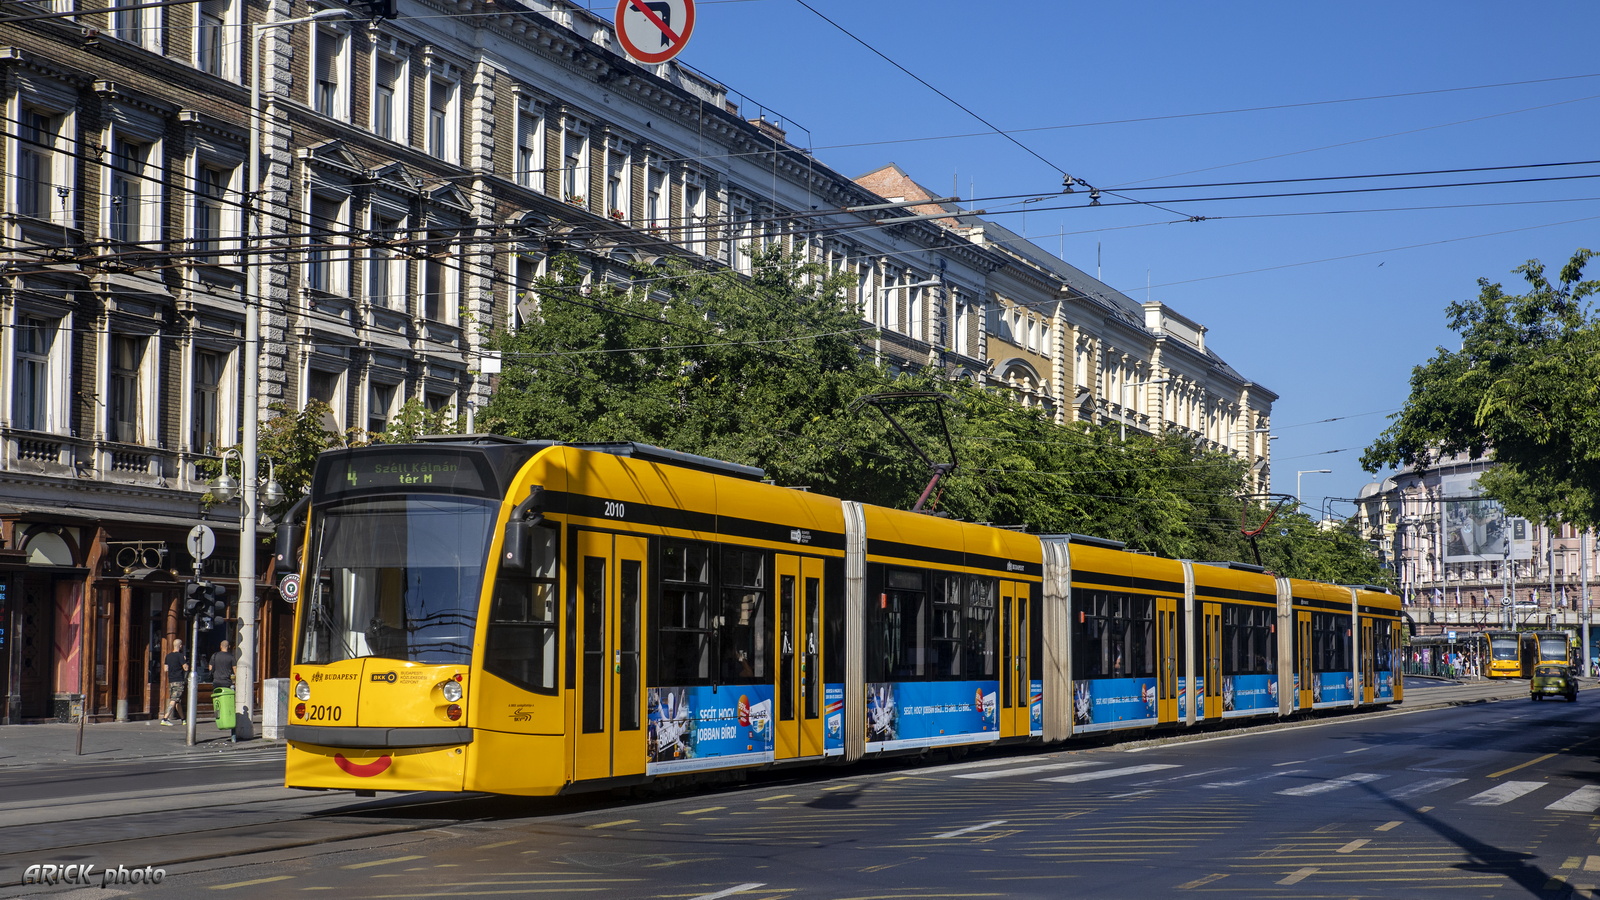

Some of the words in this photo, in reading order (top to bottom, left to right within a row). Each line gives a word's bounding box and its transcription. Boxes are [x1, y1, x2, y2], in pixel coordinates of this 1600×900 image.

[375, 463, 407, 473] Széll
[412, 461, 457, 472] Kálmán
[347, 464, 357, 486] 4
[399, 474, 419, 484] tér
[424, 474, 432, 483] M
[604, 501, 625, 518] 2010
[324, 673, 358, 681] BUDAPEST
[310, 705, 342, 722] 2010
[719, 708, 735, 721] HOGY
[697, 728, 721, 744] JOBBAN
[721, 724, 737, 739] BÍRD!
